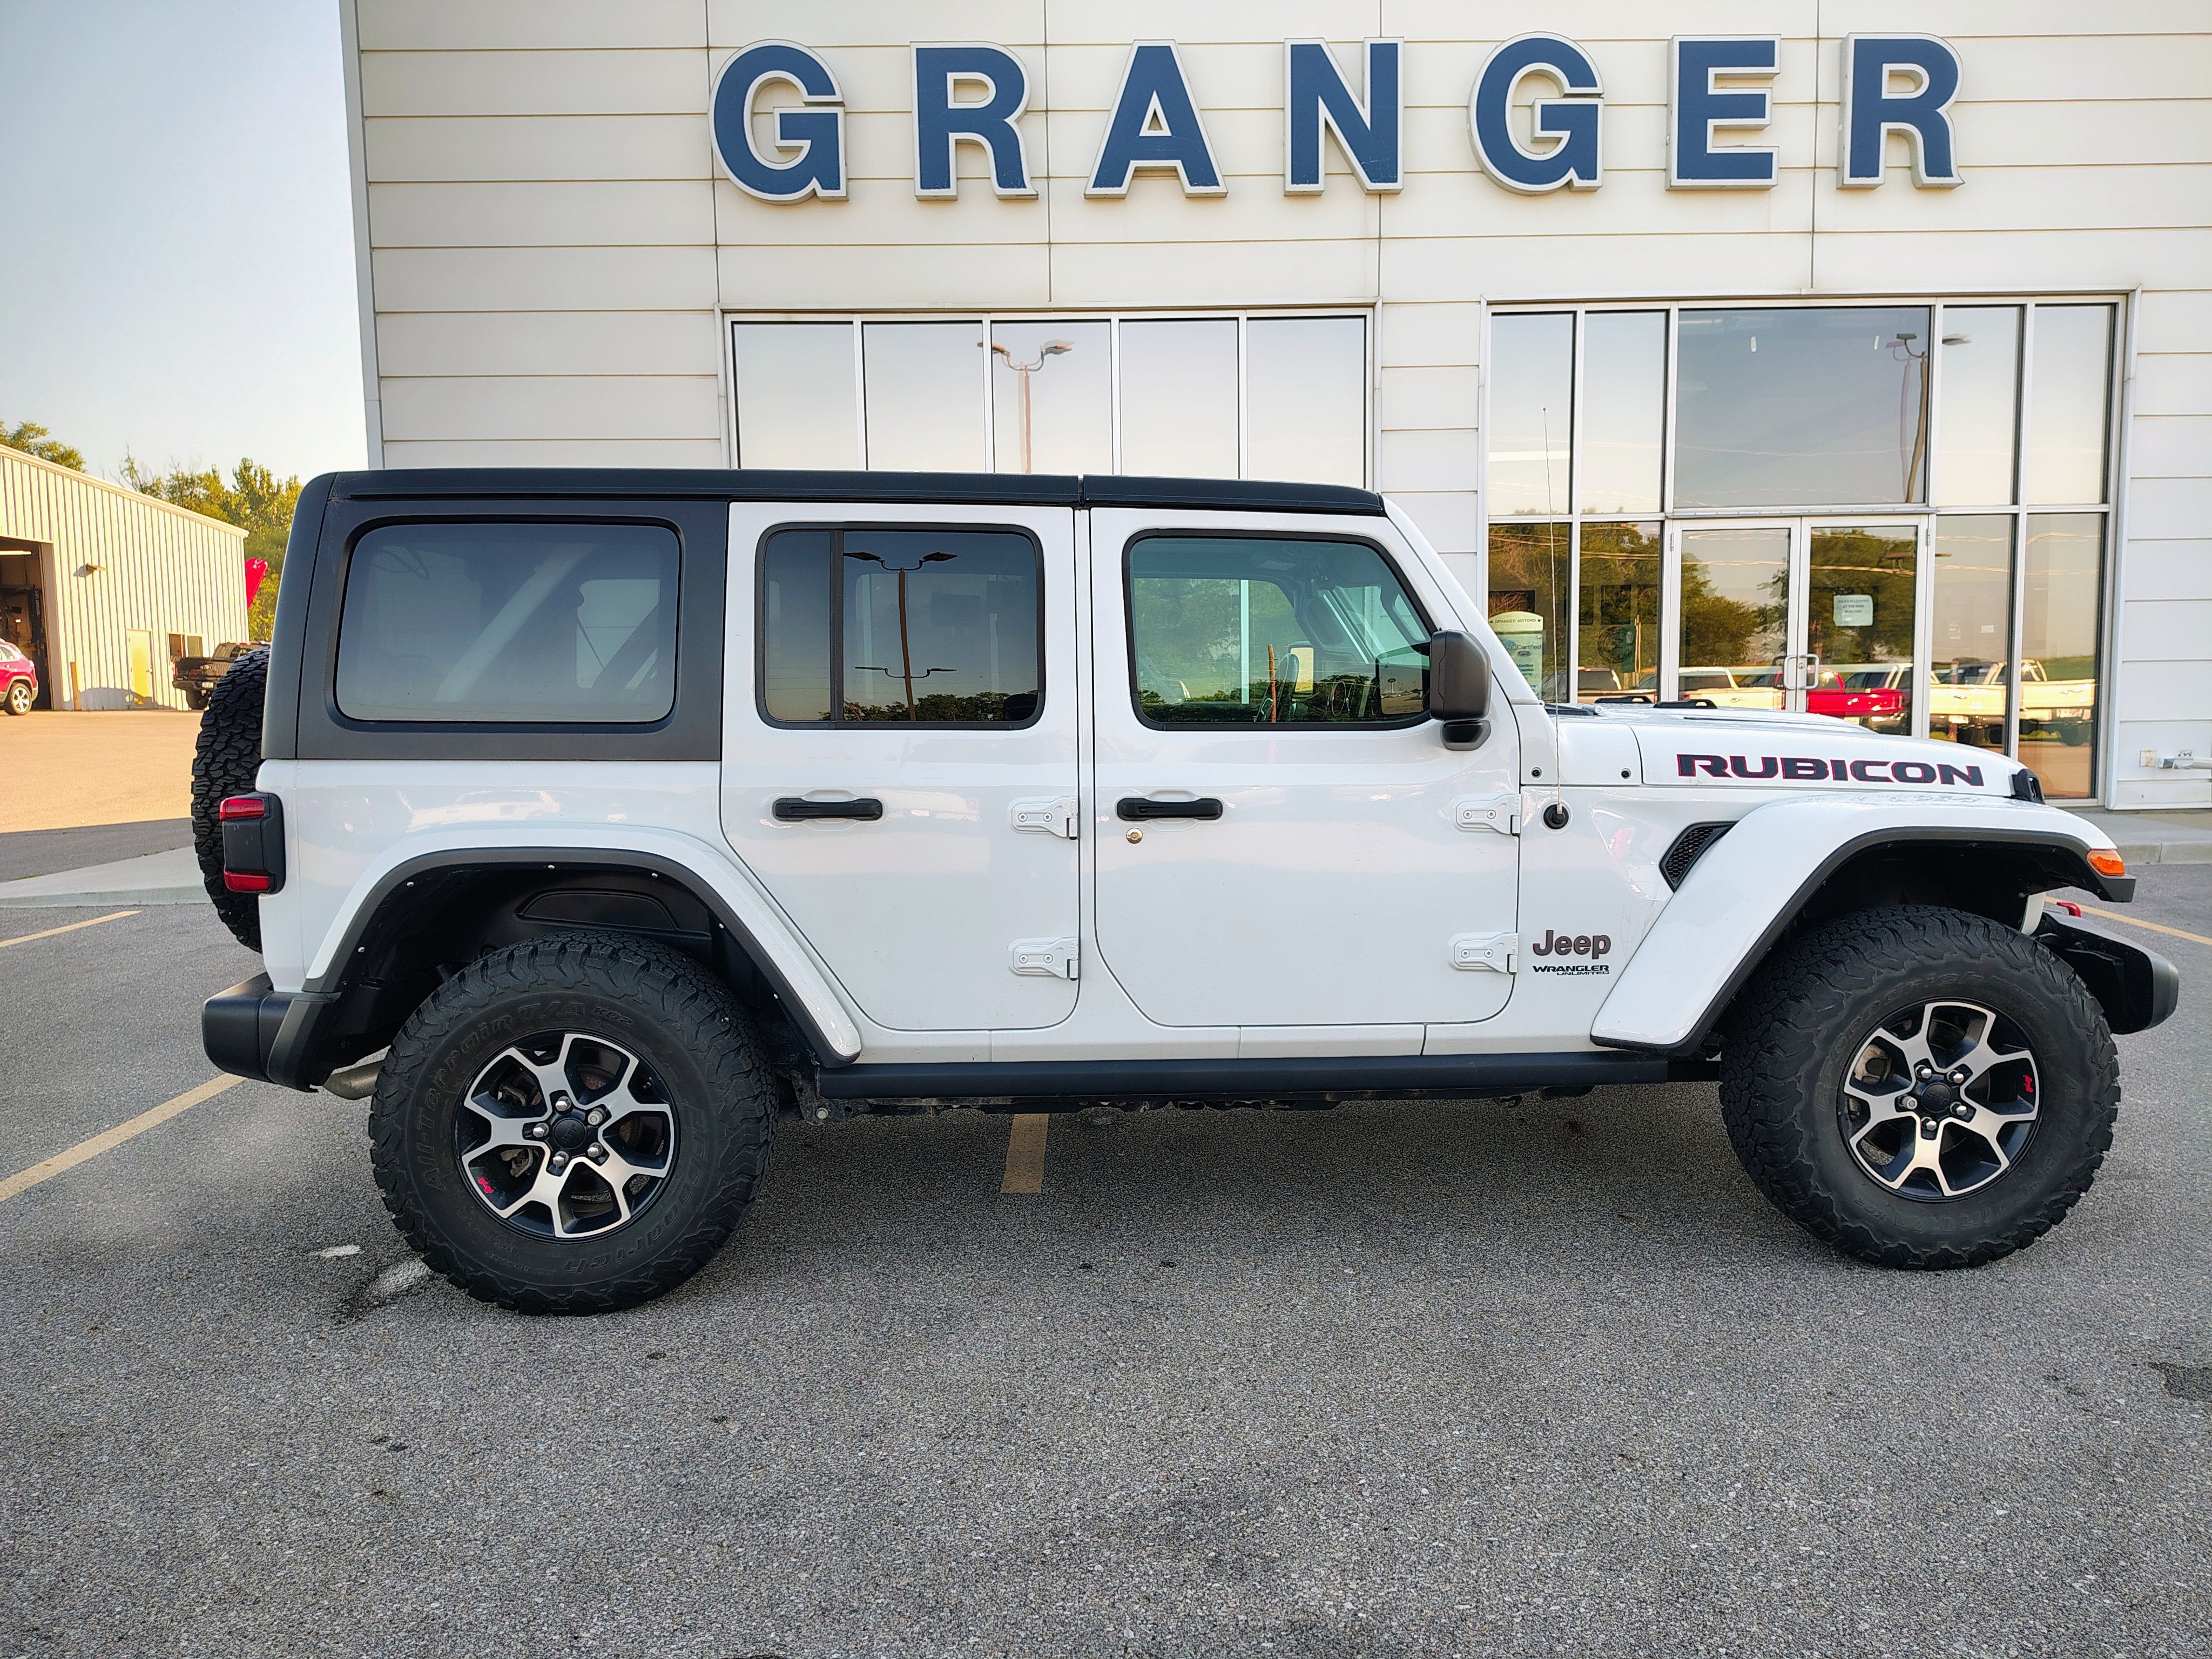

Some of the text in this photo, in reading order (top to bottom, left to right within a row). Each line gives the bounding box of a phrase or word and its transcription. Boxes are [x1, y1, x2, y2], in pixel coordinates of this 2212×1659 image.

[708, 31, 1965, 205] GRANGER
[1676, 754, 1985, 787] RUBICON
[1533, 929, 1611, 960] Jeep
[1533, 965, 1609, 973] WRANGLER
